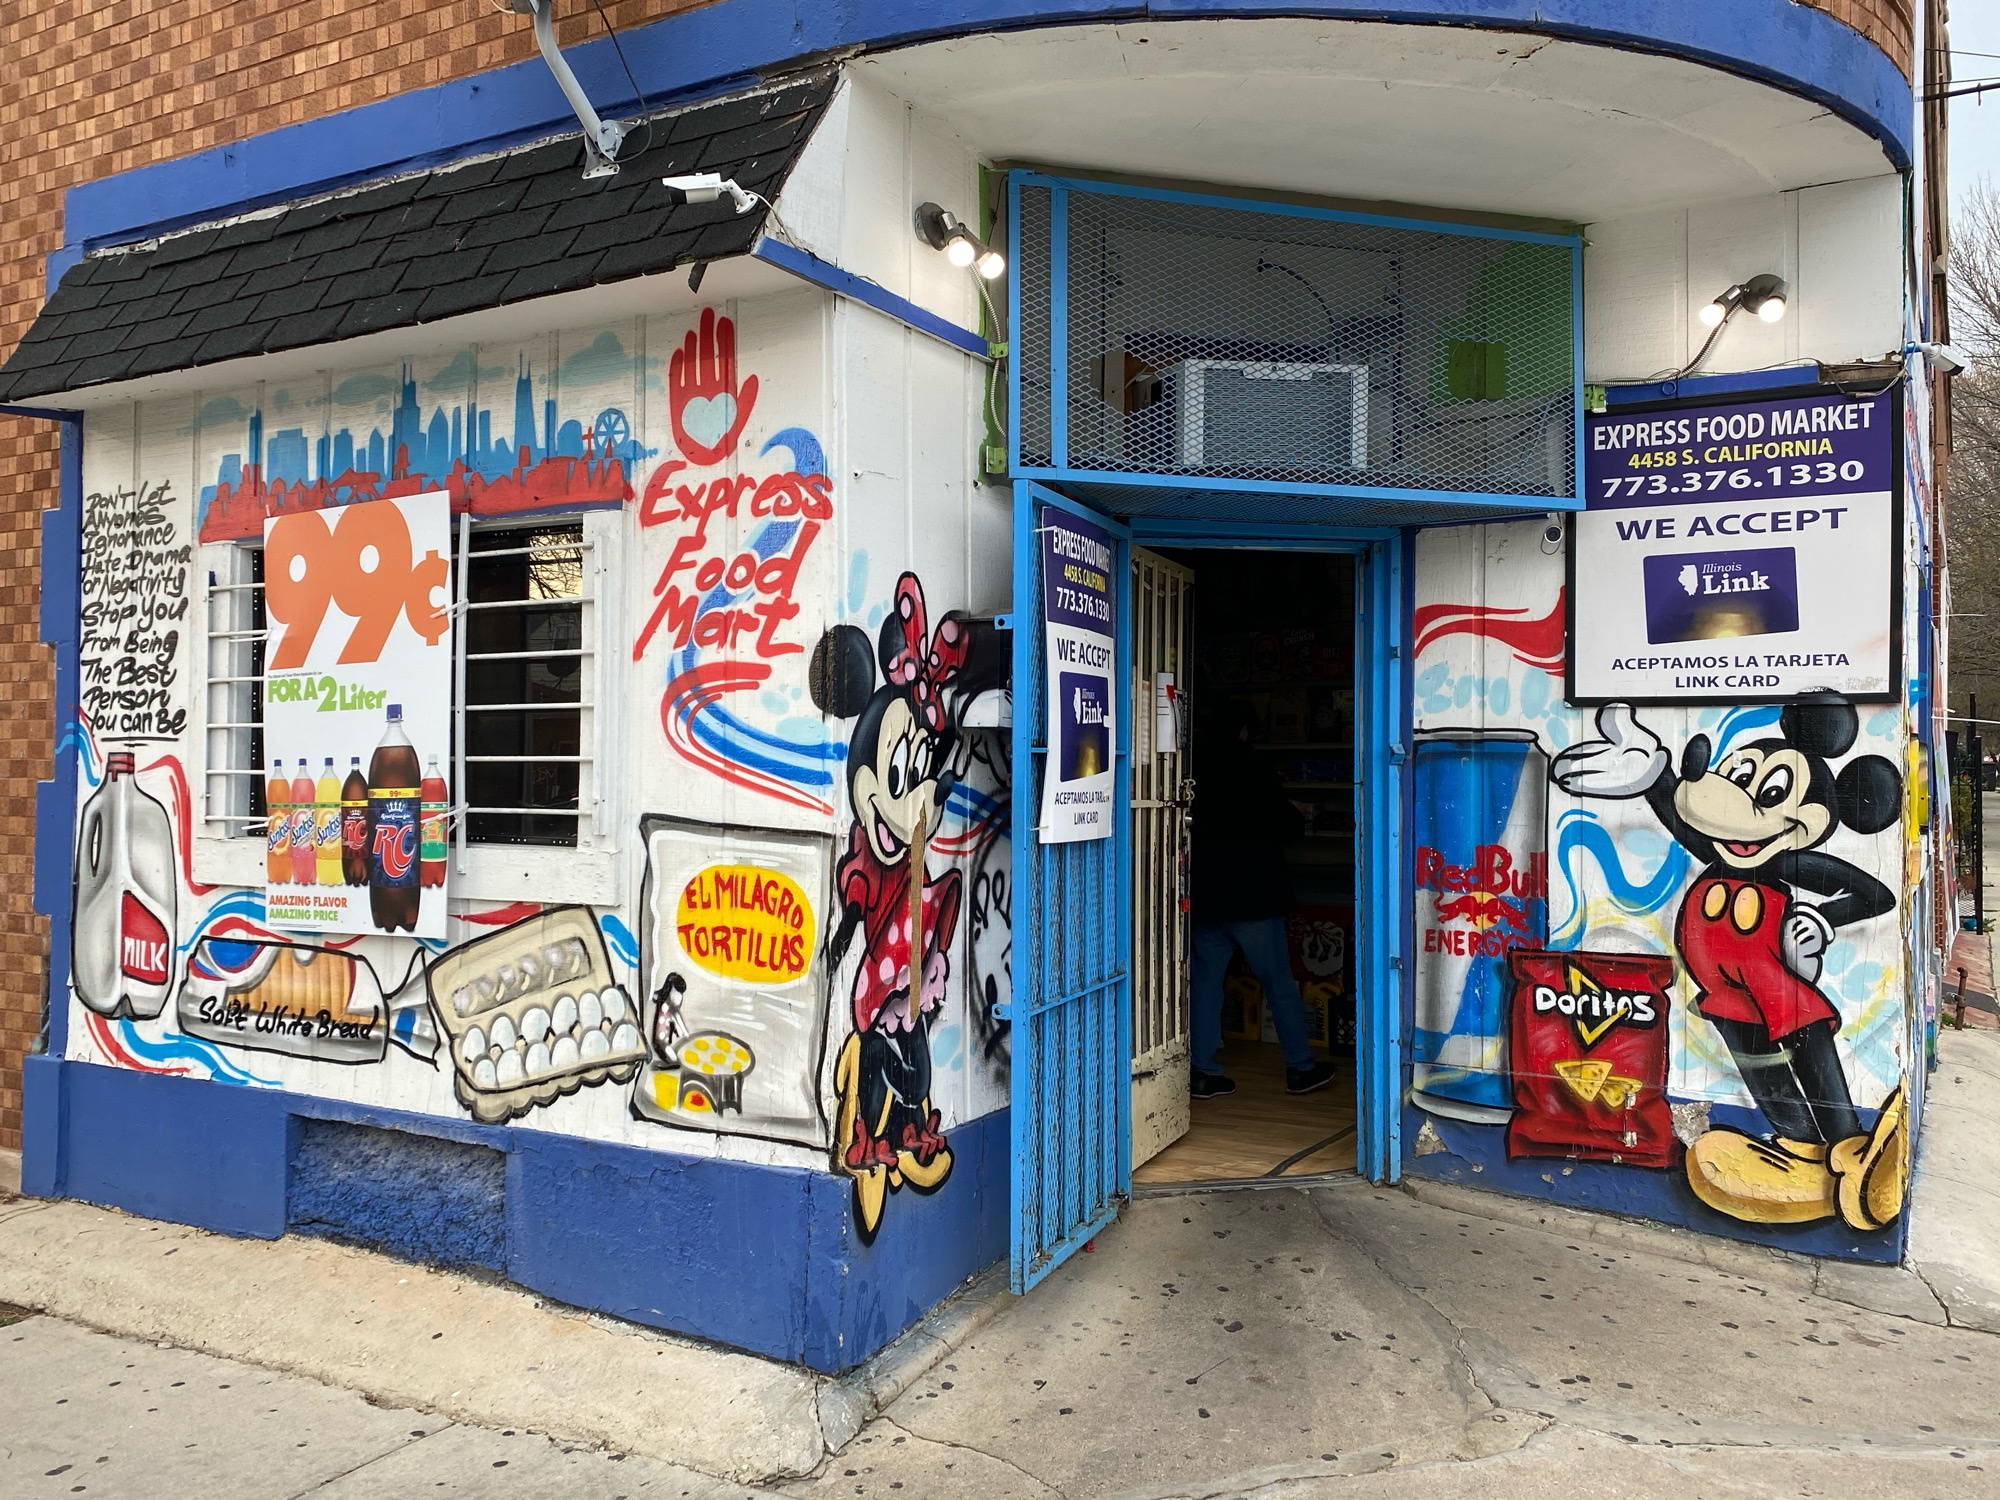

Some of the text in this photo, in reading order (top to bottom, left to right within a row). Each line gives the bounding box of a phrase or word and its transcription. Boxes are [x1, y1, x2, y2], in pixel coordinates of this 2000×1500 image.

[1593, 402, 1875, 451] EXPRESS FOOD MARKET
[1628, 438, 1834, 469] 4458 S. CALIFORNIA
[137, 479, 177, 510] Let
[1602, 460, 1865, 498] 773.376.1330
[638, 460, 834, 536] Express
[82, 523, 177, 557] Ignorance
[1615, 507, 1848, 541] WE ACCEPT
[653, 519, 821, 599] Food
[1053, 526, 1081, 560] EXPRESS
[126, 544, 192, 577] Drama
[1701, 561, 1742, 575] Illinois
[83, 567, 188, 604] or Negativity
[265, 499, 450, 670] 99¢
[1703, 571, 1770, 595] Link
[82, 600, 138, 637] Stop
[1056, 586, 1110, 623] 773.376.1330
[633, 584, 805, 662] Mart
[80, 629, 179, 666] From Being
[1057, 637, 1111, 670] WE ACCEPT
[1610, 653, 1850, 671] ACEPTAMOS LA TARJETA
[81, 656, 178, 688] The Best
[1675, 673, 1781, 689] LINK CARD
[82, 685, 171, 712] Person
[268, 675, 387, 713] FOR A 2 Liter
[155, 708, 188, 736] Be
[1081, 701, 1103, 724] Link
[372, 824, 416, 878] RC
[269, 894, 348, 908] AMAZING FLAVOR
[269, 908, 339, 921] AMAZING PRICE
[684, 870, 805, 932] EL MILAGRO
[123, 936, 167, 972] MILK
[677, 922, 805, 973] TORTILLAS
[1424, 928, 1516, 960] ENERGY
[255, 1001, 314, 1038] White
[315, 1004, 380, 1040] Bread
[1534, 986, 1656, 1023] Doritos
